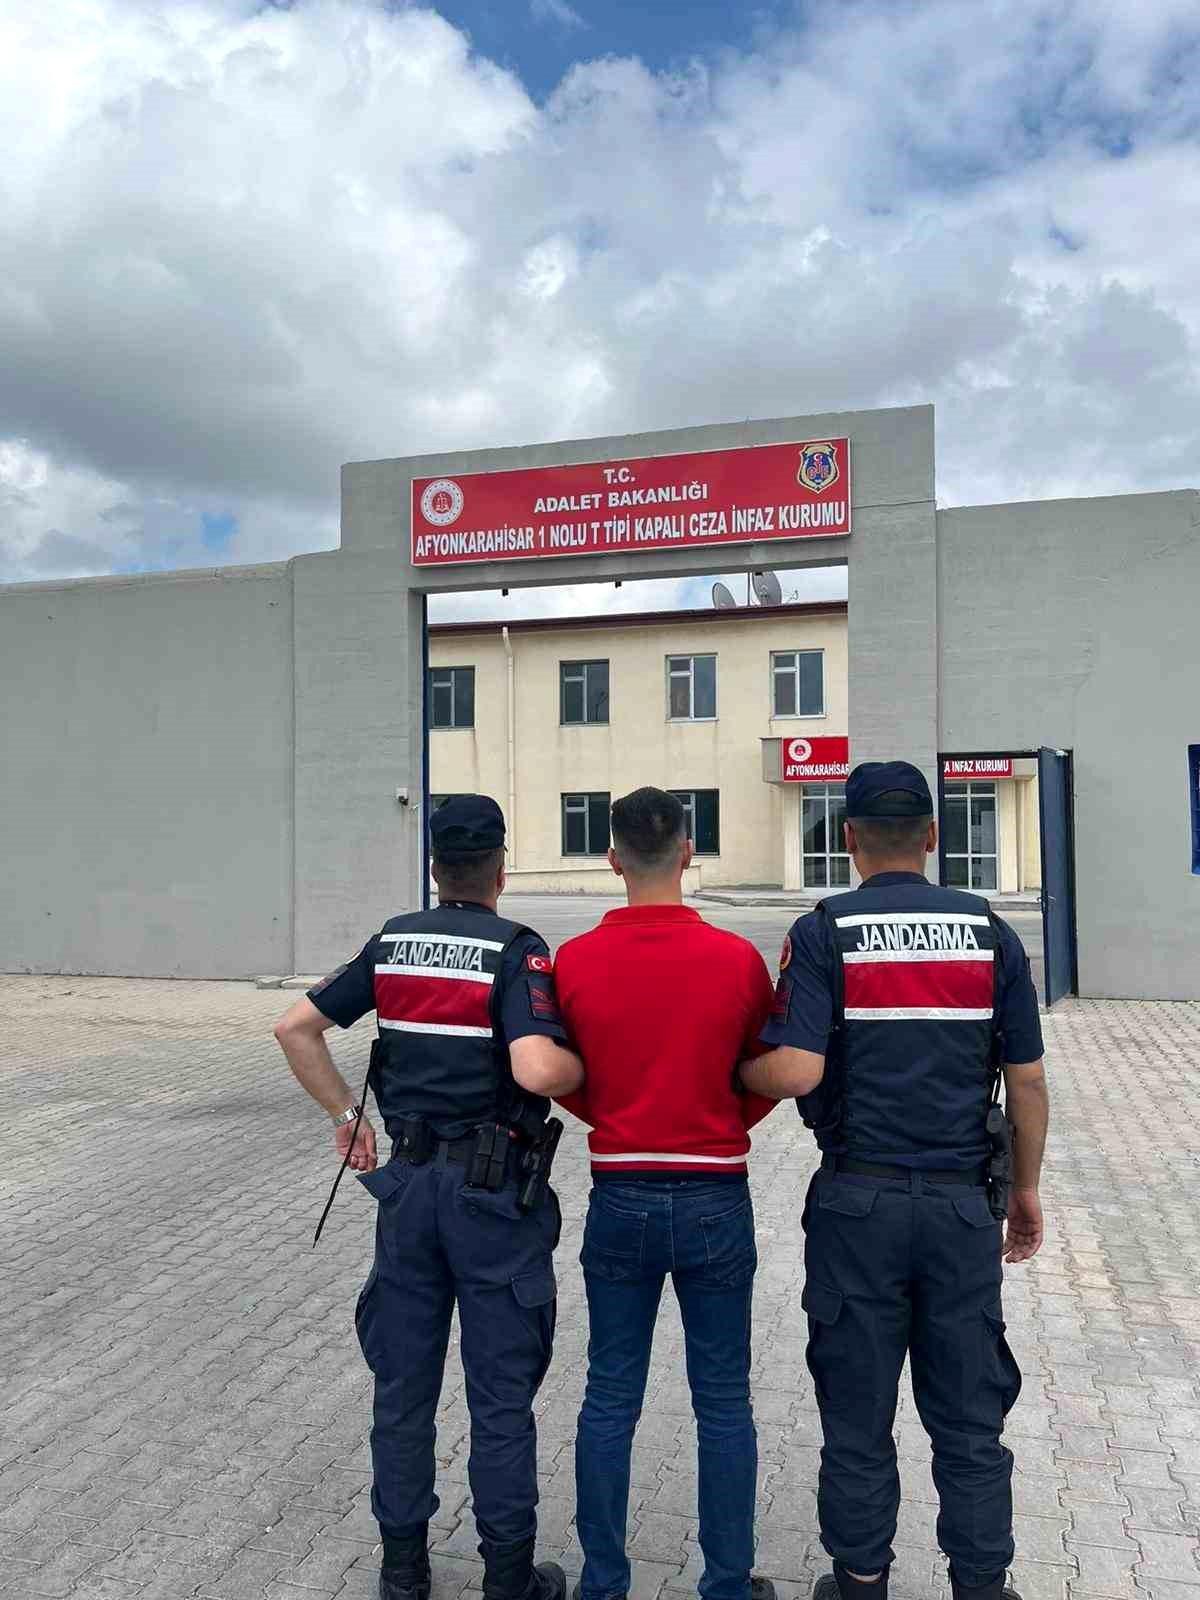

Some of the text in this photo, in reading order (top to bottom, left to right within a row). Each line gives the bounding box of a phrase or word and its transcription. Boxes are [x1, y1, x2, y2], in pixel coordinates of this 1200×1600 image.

[603, 467, 636, 485] T.C.
[534, 480, 708, 513] ADALET BAKANLIĞI
[415, 501, 845, 557] AFYONKARAHİSAR 1 NOLU T TİPİ KAPALI CEZA İNFAZ KURUMU
[975, 759, 1009, 772] KURUMU
[857, 923, 978, 951] JANDARMA
[387, 939, 482, 971] JANDARMA
